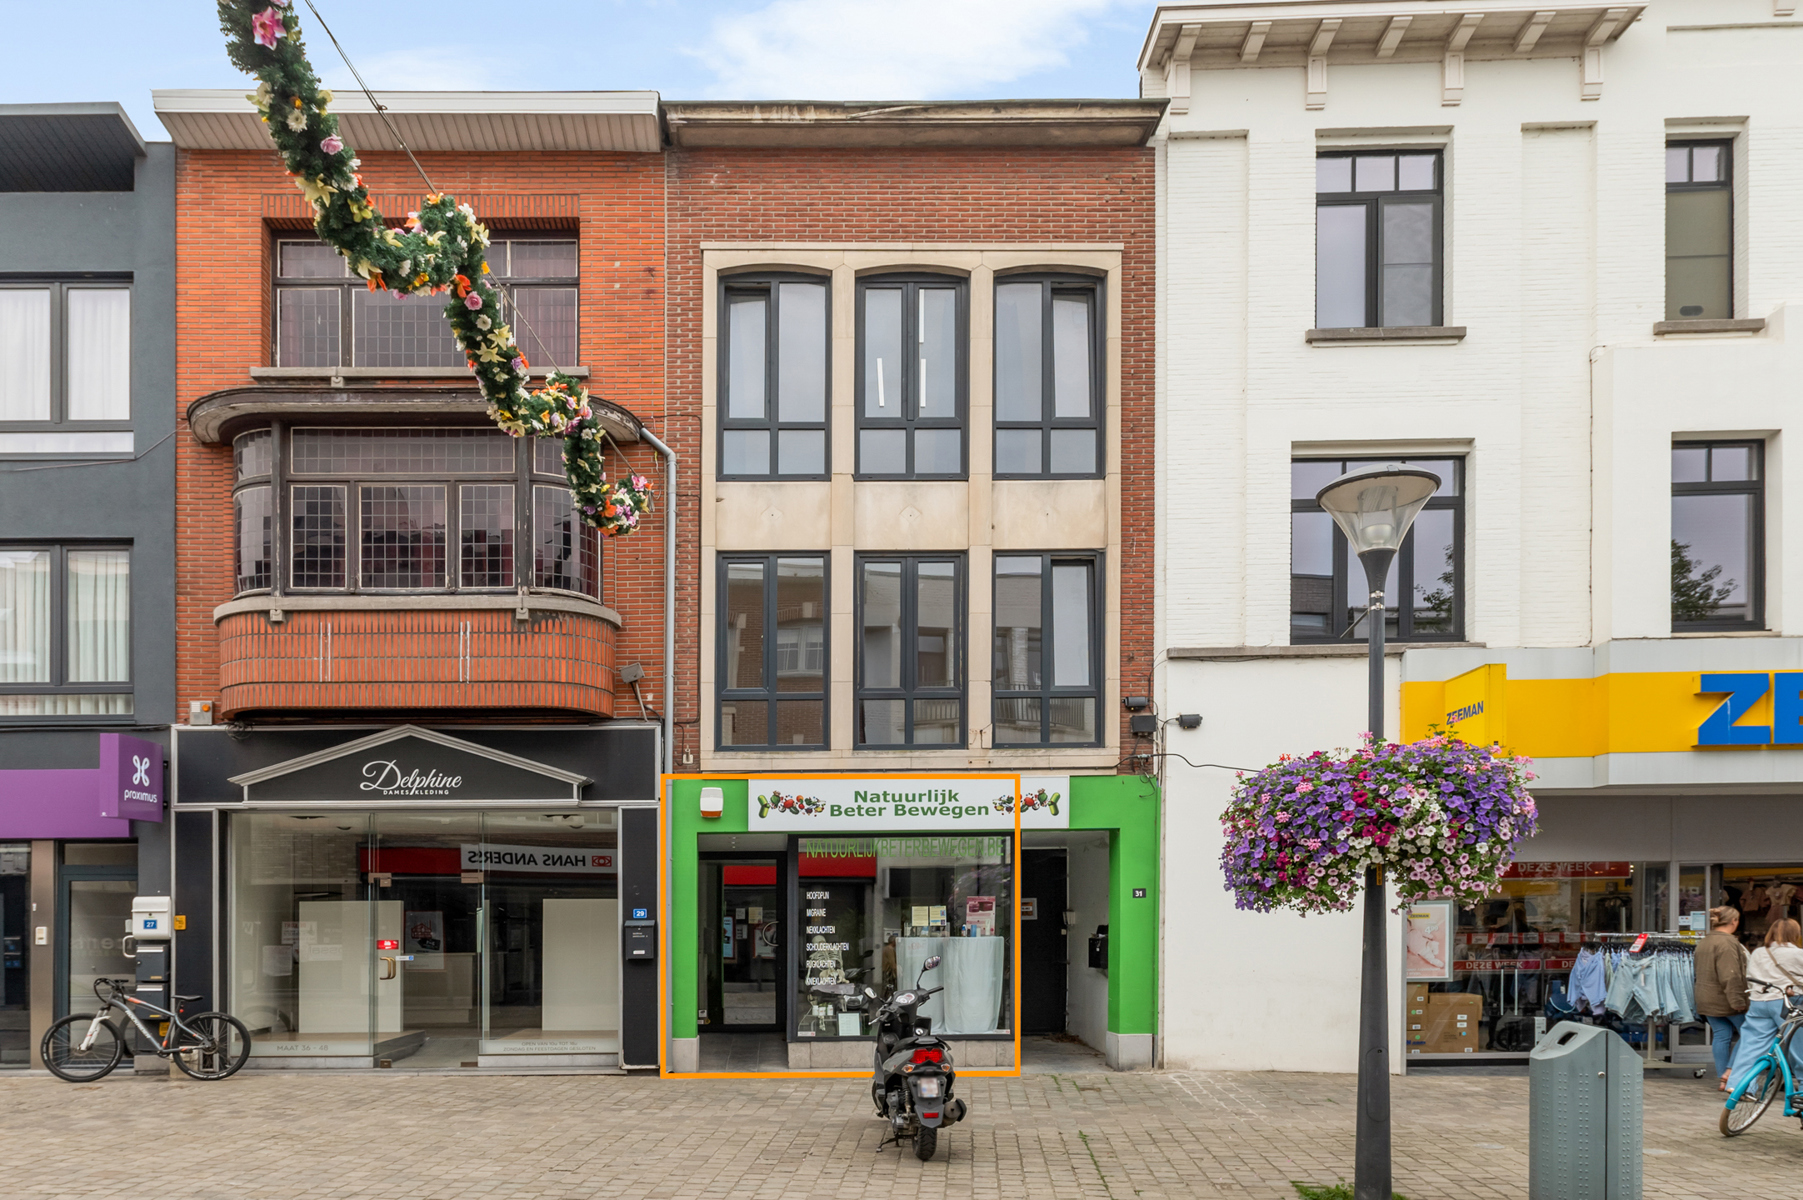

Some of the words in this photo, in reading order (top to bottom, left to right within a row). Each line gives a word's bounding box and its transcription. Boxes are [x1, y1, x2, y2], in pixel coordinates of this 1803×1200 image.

[360, 759, 462, 795] Delphine
[124, 789, 158, 803] proximus
[854, 789, 960, 805] Natuurlijk
[830, 804, 886, 817] Beter
[894, 804, 989, 819] Bewegen
[806, 837, 1004, 858] NATUURLIJKBETERBEWEGEN.BE
[1518, 862, 1552, 872] DEZE
[1555, 861, 1593, 871] WEEK
[806, 891, 830, 900] HOOFDPIJN
[806, 925, 836, 934] NEKKLACHTEN
[806, 942, 850, 951] SCHOUDERKLACHTEN
[1466, 961, 1492, 969] DEZE
